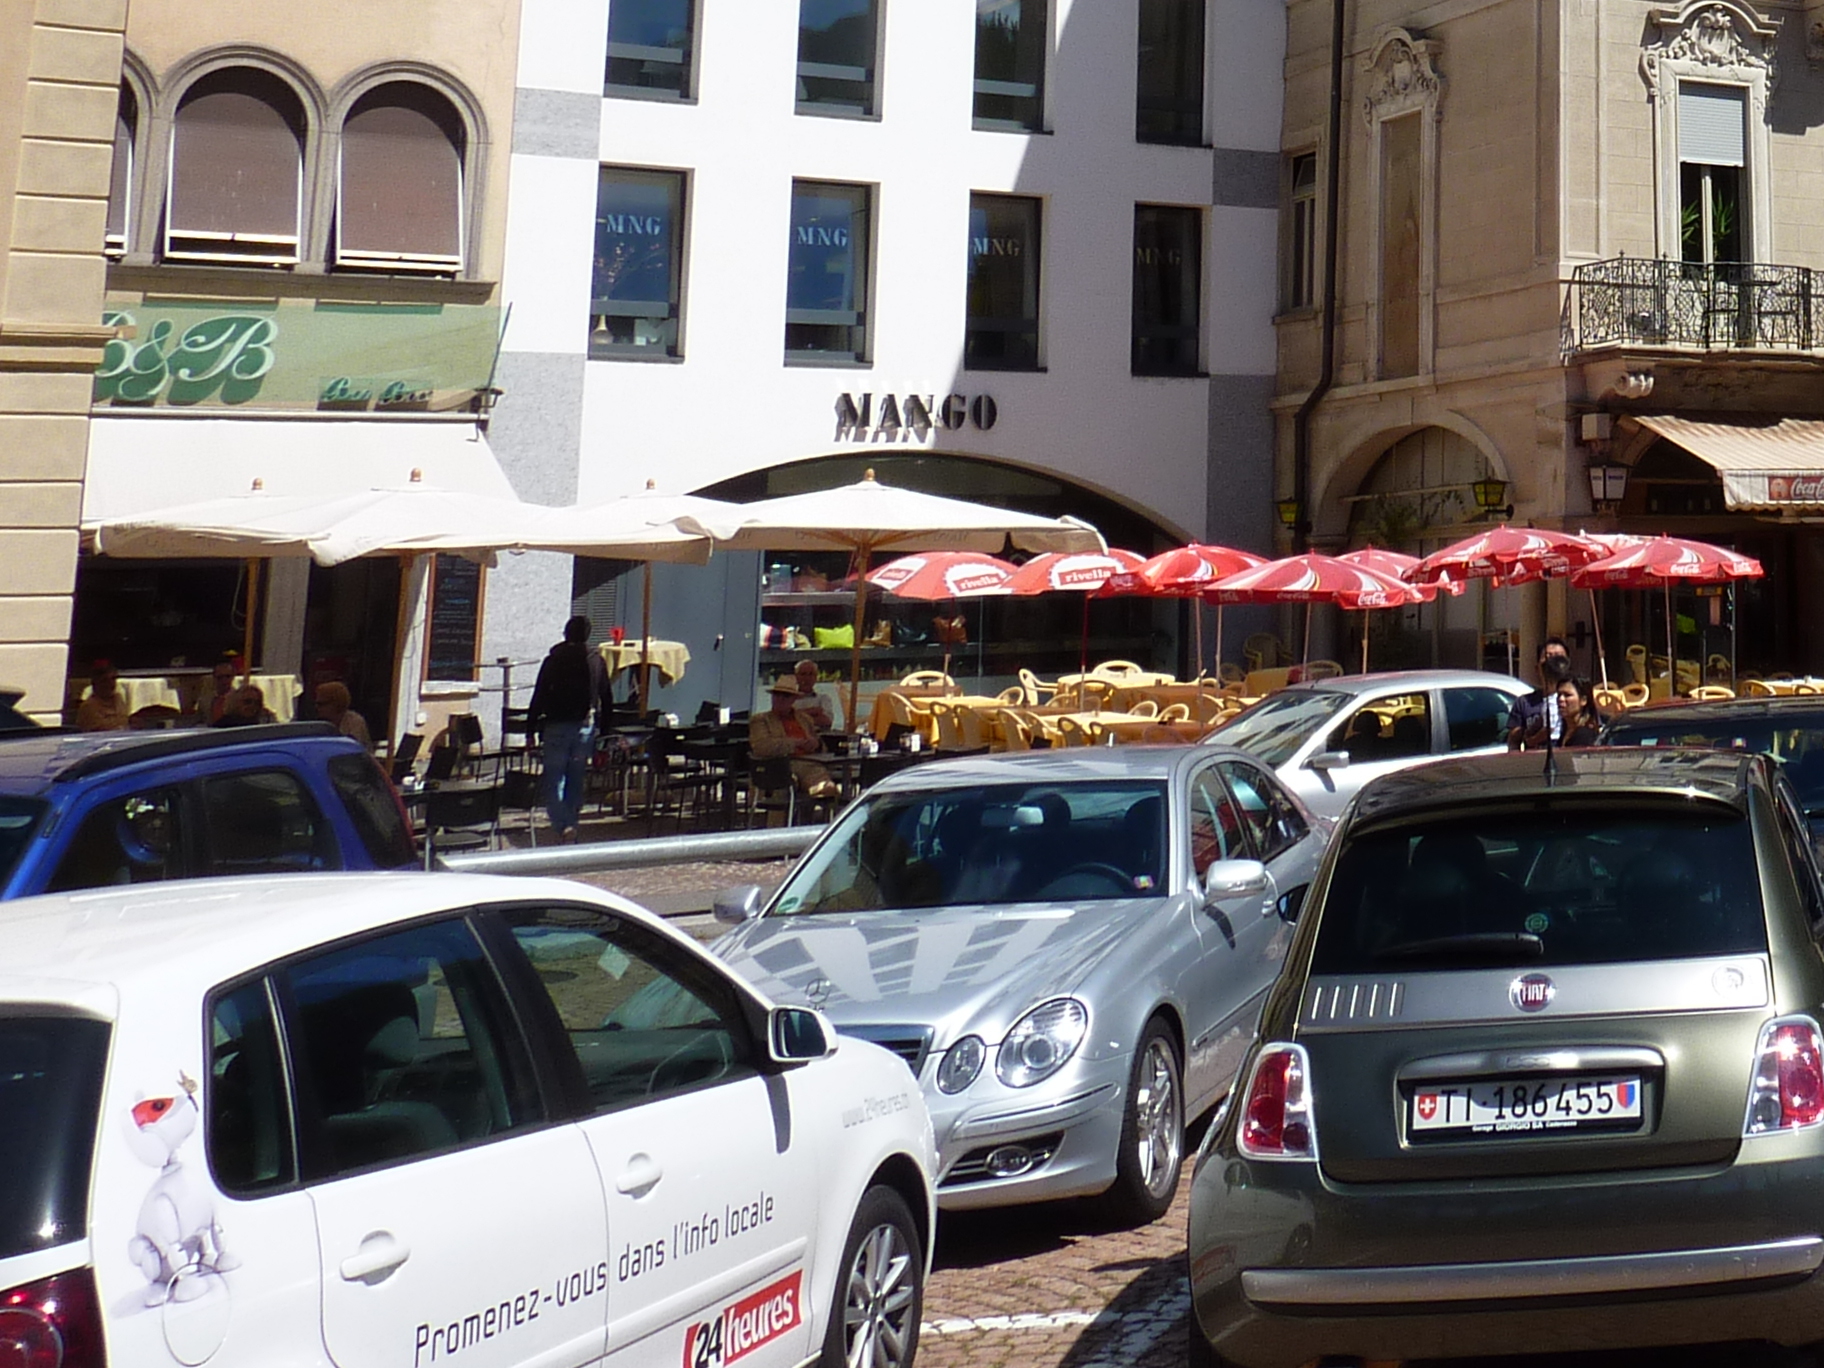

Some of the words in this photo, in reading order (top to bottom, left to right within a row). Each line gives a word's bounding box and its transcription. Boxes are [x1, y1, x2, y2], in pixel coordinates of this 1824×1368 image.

[606, 214, 662, 235] MNG
[797, 226, 848, 248] MNG
[973, 237, 1020, 256] MNG
[837, 393, 998, 431] MANGO
[960, 575, 999, 591] rivella
[1065, 568, 1112, 583] rivella
[415, 1260, 608, 1368] Promenez-vous
[618, 1238, 665, 1282] dans
[673, 1211, 720, 1260] l'info
[725, 1191, 774, 1238] locale
